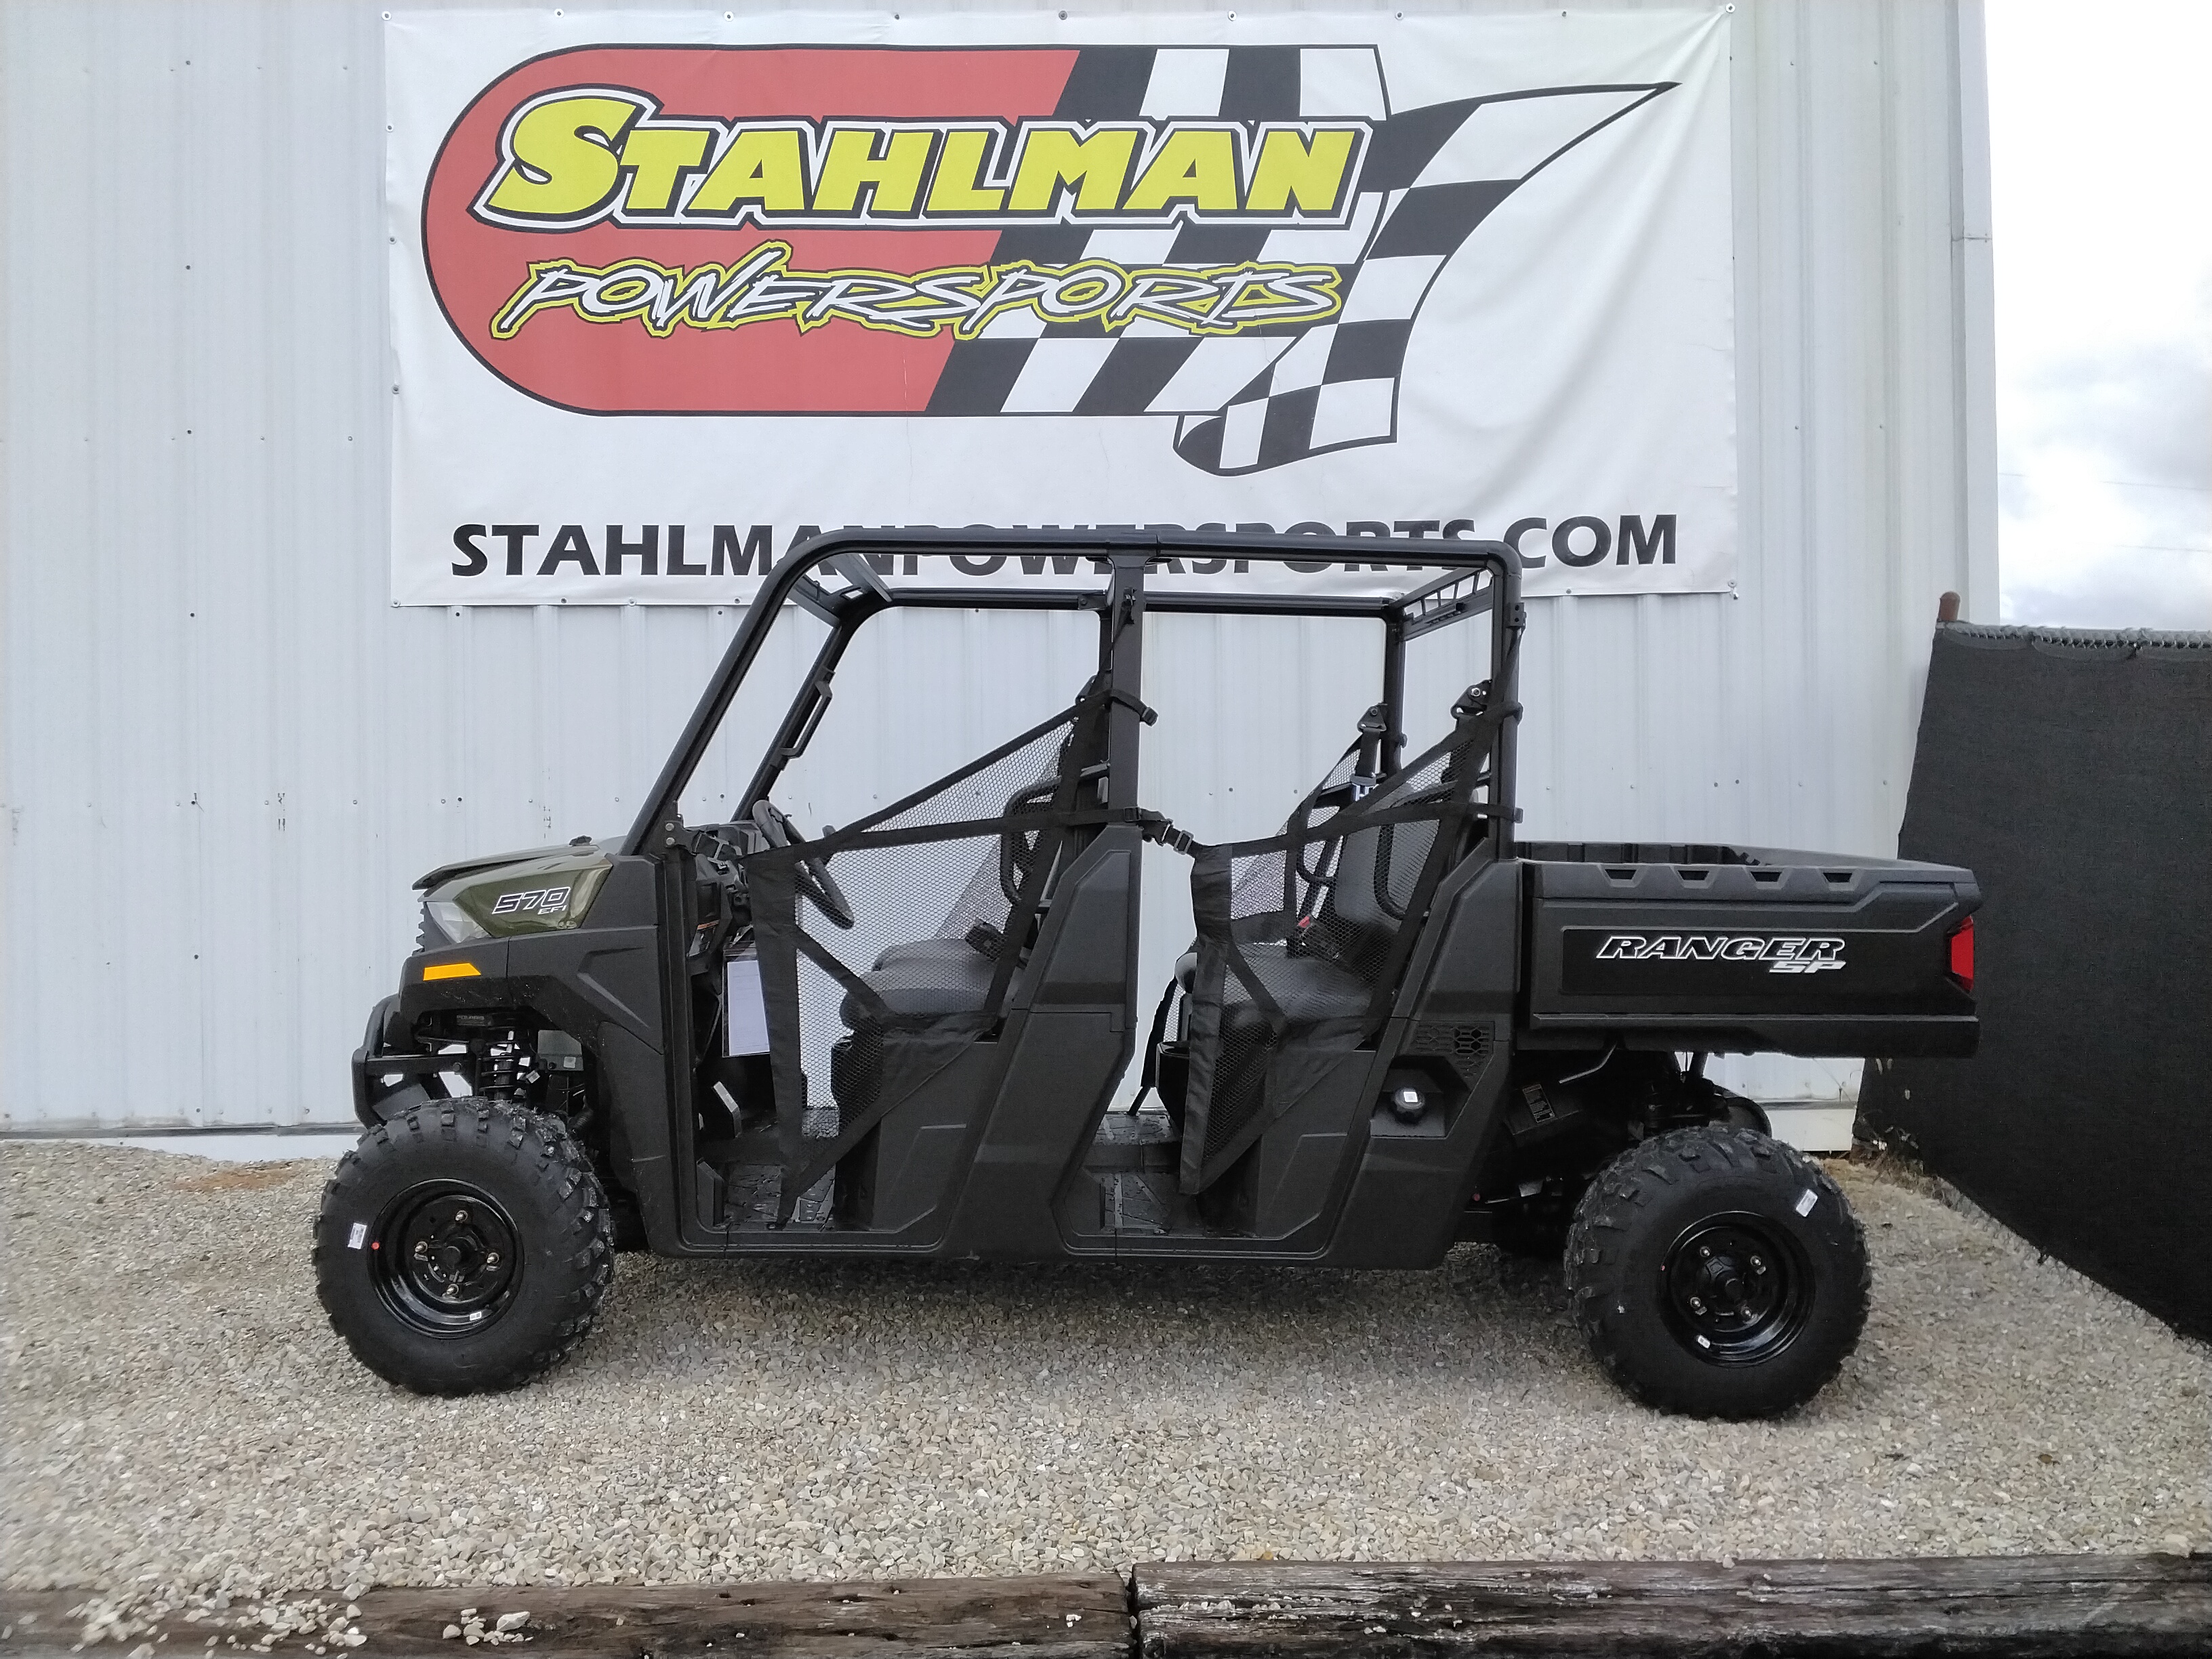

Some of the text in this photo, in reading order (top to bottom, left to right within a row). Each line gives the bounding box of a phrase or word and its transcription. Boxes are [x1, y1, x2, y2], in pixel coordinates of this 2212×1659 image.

[471, 89, 1370, 226] STAHLMAN
[492, 240, 1340, 337] POWERSPORTS
[451, 514, 1677, 577] STAHLMAOWSORTCOM
[492, 886, 571, 914] 570
[537, 905, 567, 915] EFI
[1597, 936, 1845, 960] RANGER
[1769, 960, 1846, 973] SP
